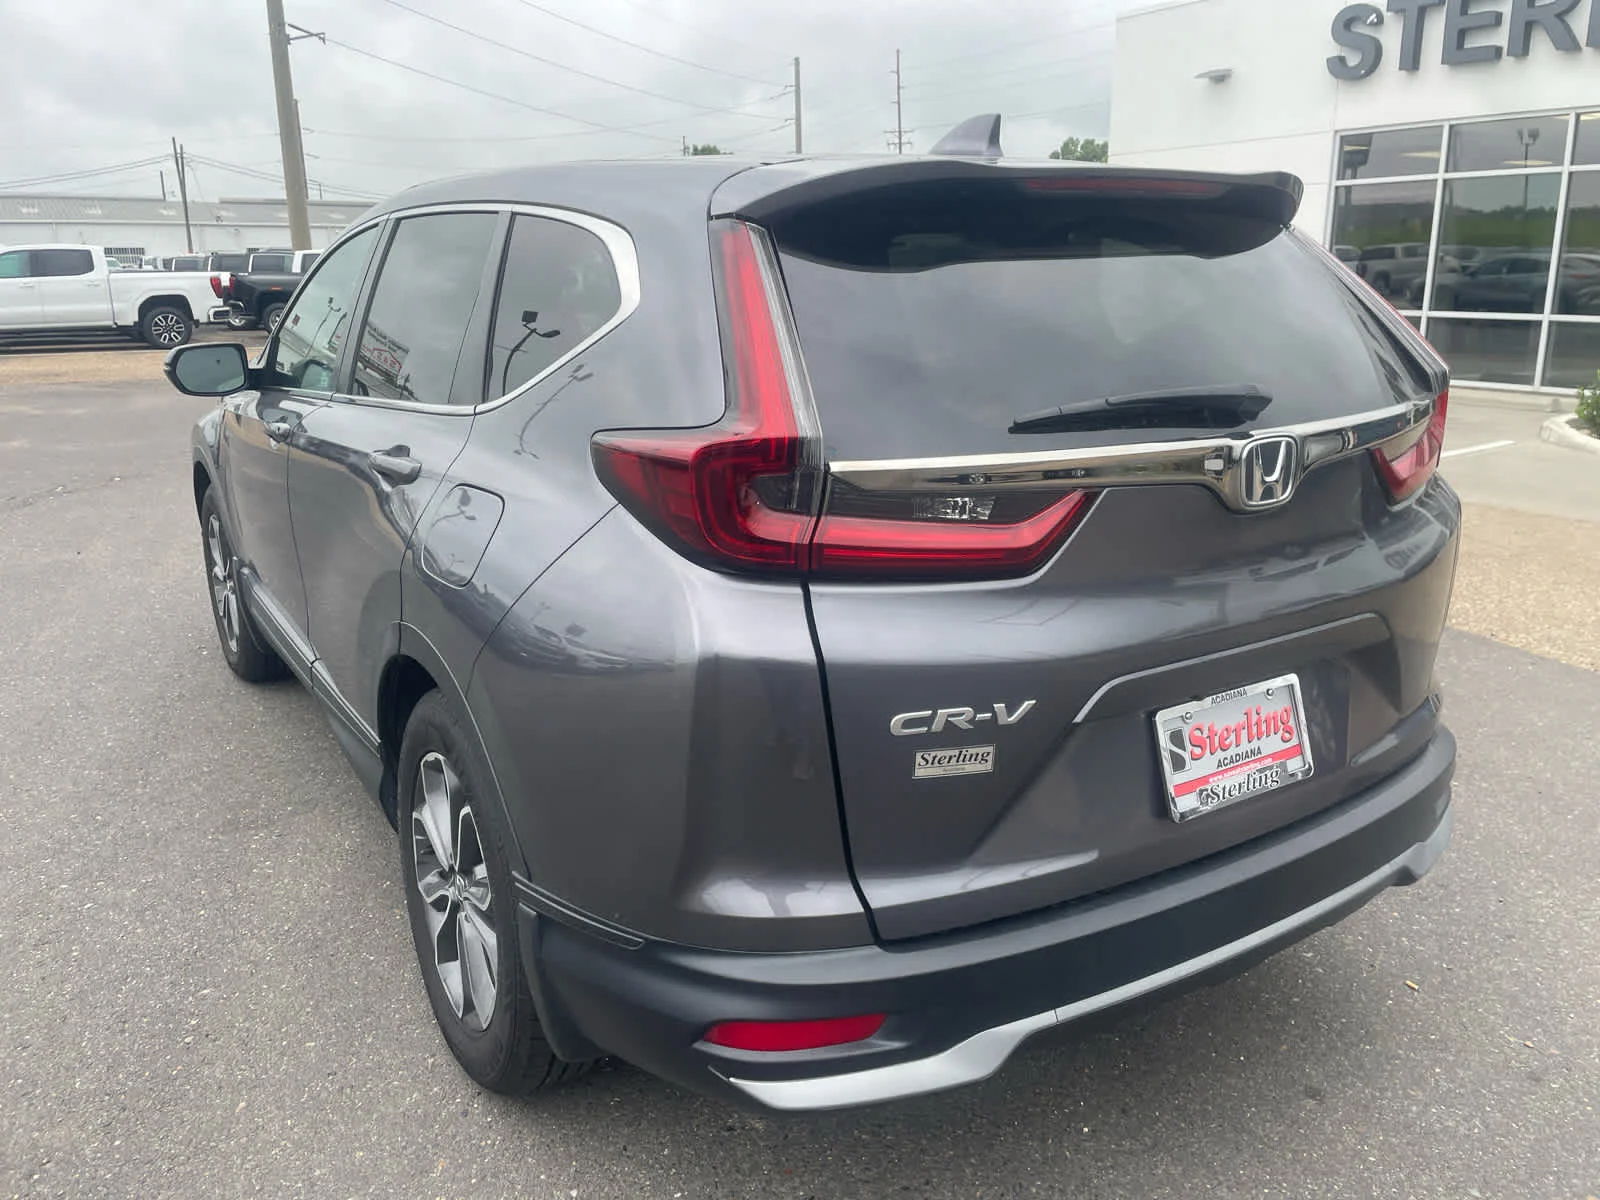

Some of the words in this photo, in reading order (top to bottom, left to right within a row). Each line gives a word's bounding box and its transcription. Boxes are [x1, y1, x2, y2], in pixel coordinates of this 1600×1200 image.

[1326, 0, 1600, 81] STER
[1211, 687, 1248, 705] ACADIANA
[889, 699, 1037, 736] CR-V
[1188, 704, 1295, 761] Sterling
[918, 749, 991, 767] Sterling
[1216, 745, 1263, 769] ACADIANA
[1207, 764, 1281, 806] Sterling
